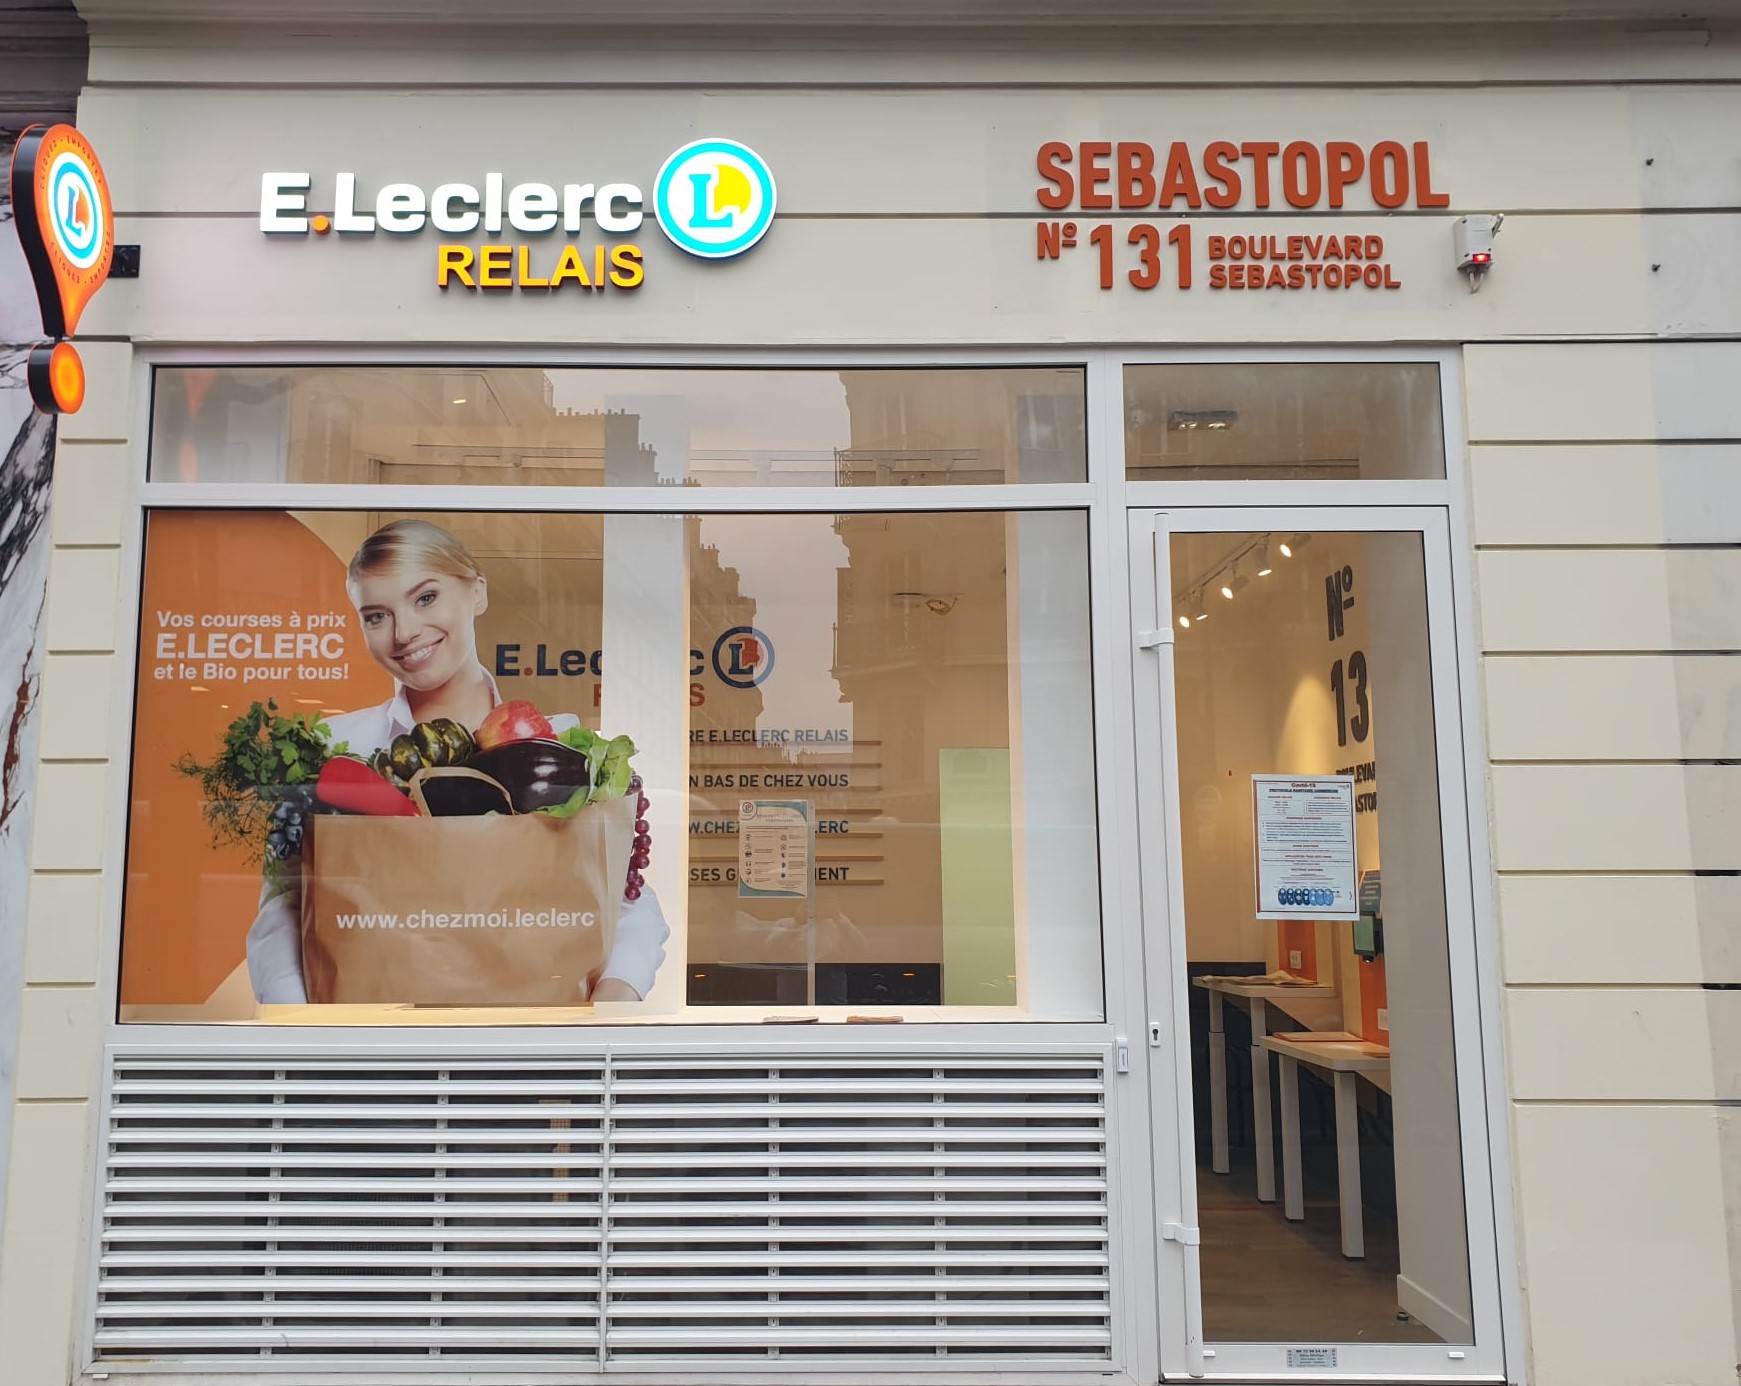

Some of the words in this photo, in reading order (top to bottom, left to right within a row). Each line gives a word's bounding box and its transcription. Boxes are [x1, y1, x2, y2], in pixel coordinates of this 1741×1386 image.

[1036, 140, 1451, 210] SEBASTOPOL
[258, 171, 645, 235] E.Leclerc
[1089, 223, 1193, 290] 131
[1207, 234, 1385, 261] BOULEVARD
[436, 243, 645, 291] RELAIS
[1208, 263, 1402, 290] SEBASTOPOL
[156, 610, 195, 628] Vos
[200, 614, 283, 628] courses
[288, 610, 301, 628] à
[306, 611, 347, 632] prix
[155, 632, 345, 661] E.LECLERC
[153, 663, 174, 681] et
[178, 662, 198, 681] le
[202, 662, 238, 681] Bio
[242, 667, 292, 684] pour
[297, 663, 350, 681] tous!
[708, 729, 791, 743] E.LECLERC
[794, 728, 849, 743] RELAIS
[704, 775, 735, 788] BAS
[739, 774, 760, 788] DE
[763, 774, 804, 788] CHEZ
[807, 773, 849, 788] VOUS
[335, 907, 595, 930] www.chezmoi.leclerc
